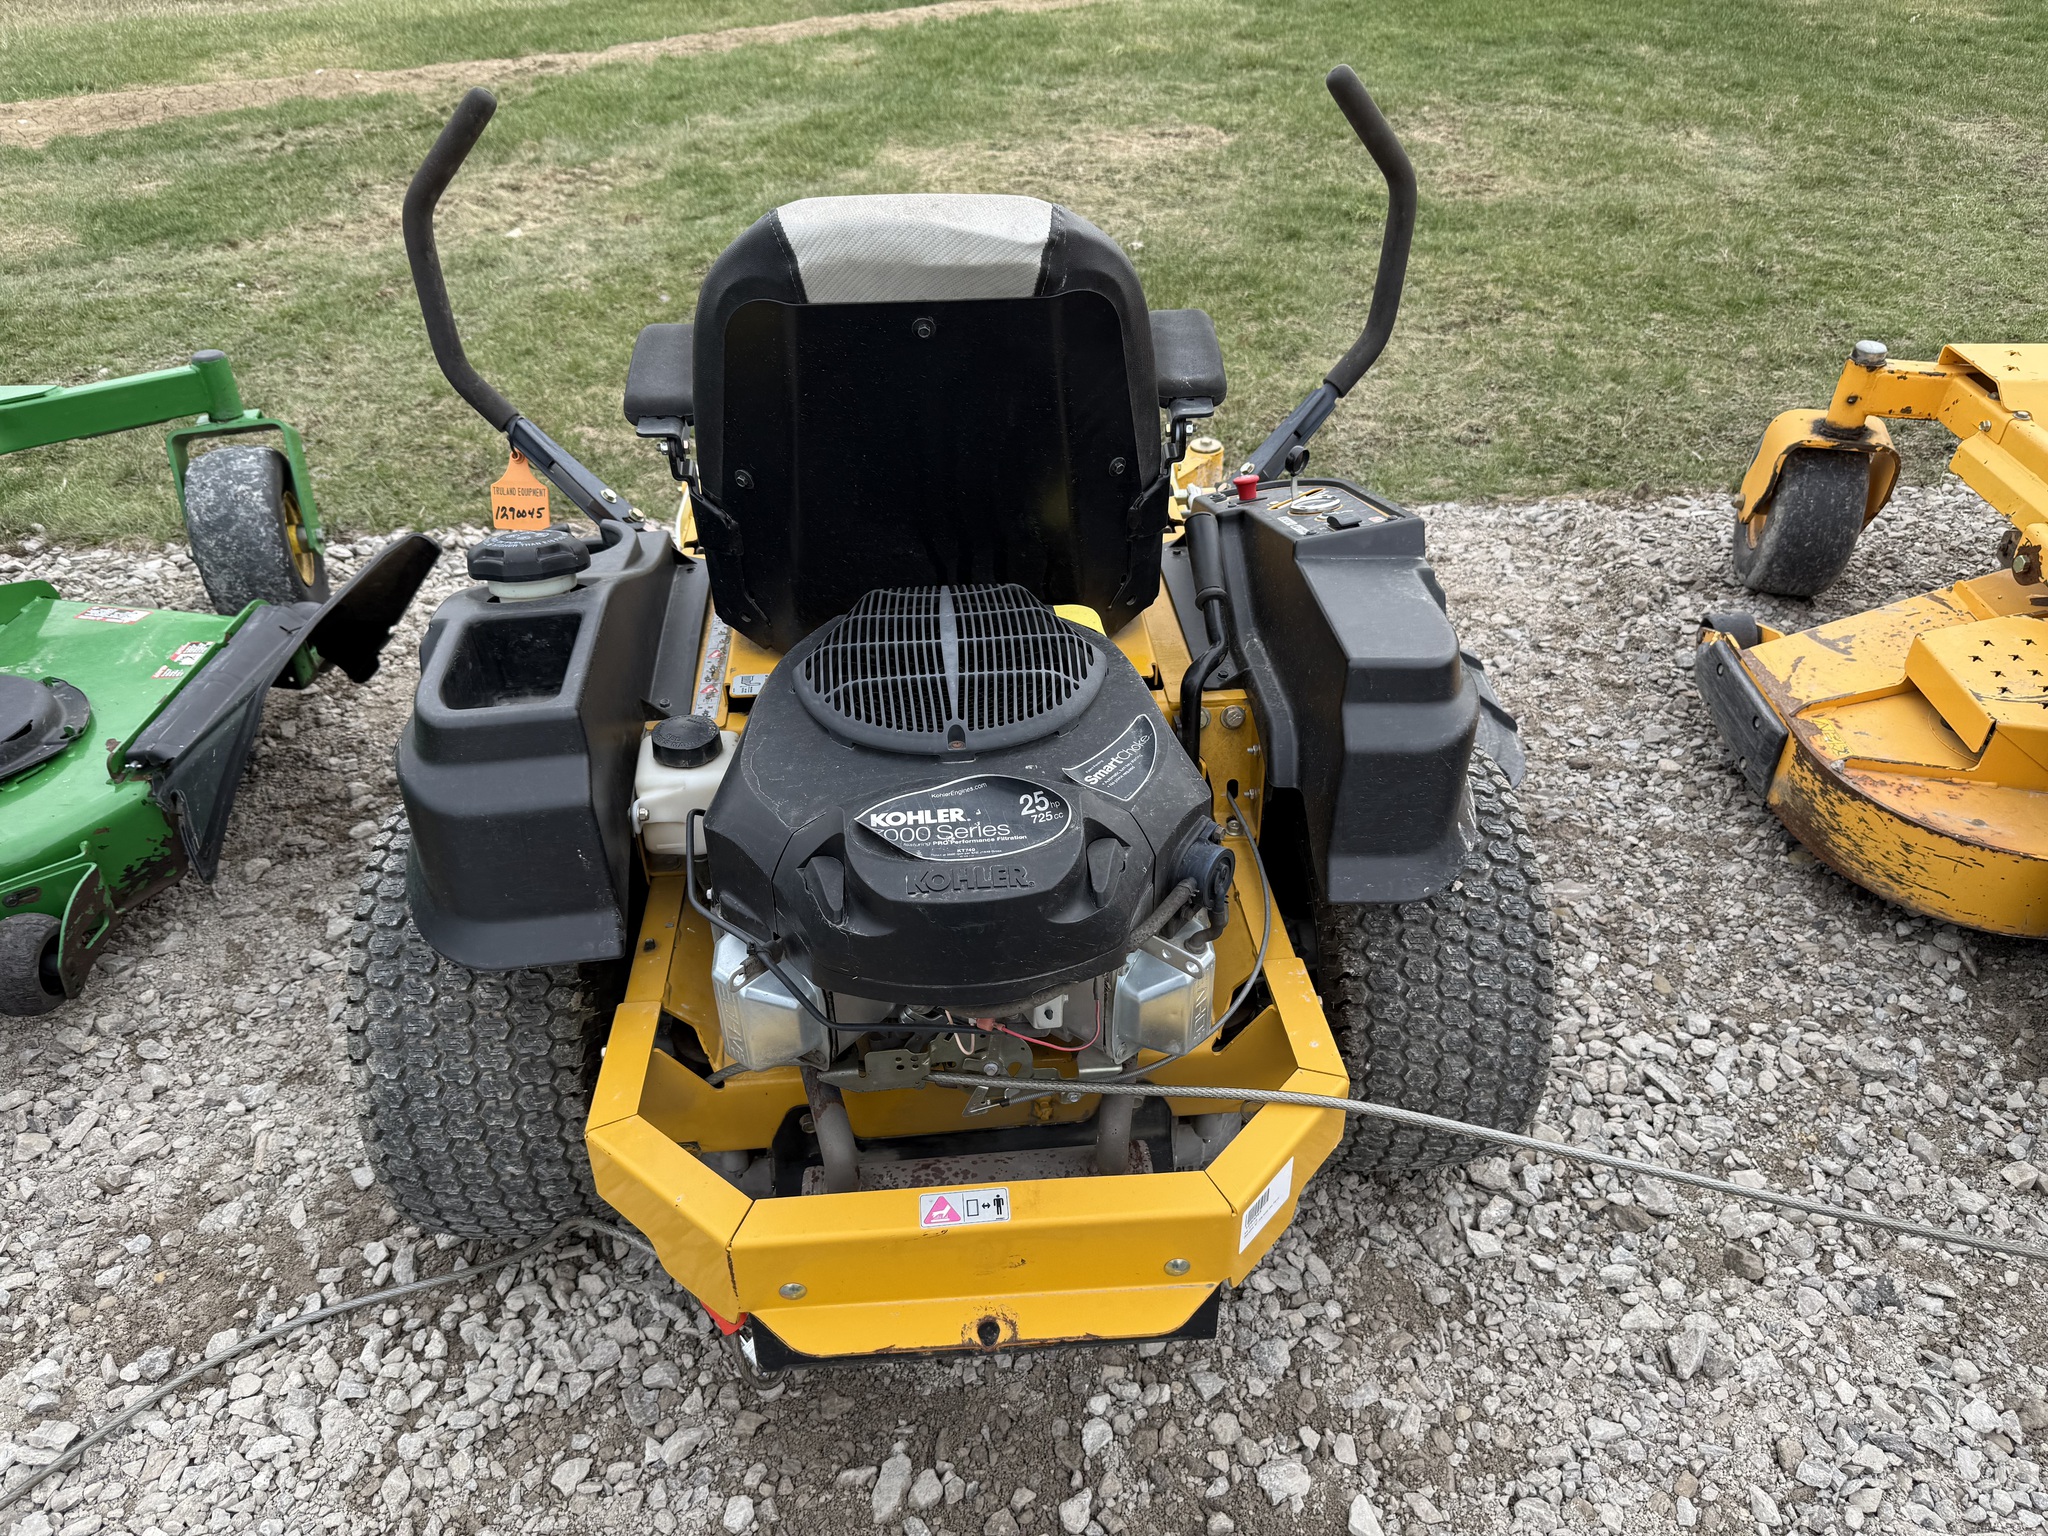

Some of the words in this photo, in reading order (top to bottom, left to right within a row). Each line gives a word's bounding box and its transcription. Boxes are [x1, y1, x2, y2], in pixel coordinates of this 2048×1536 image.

[492, 487, 516, 496] TRULAND
[518, 487, 546, 497] EQUIPMENT
[495, 506, 545, 520] 1290045
[1084, 734, 1150, 785] SmartChoke
[931, 782, 988, 799] KohlerEngines.com
[1019, 790, 1050, 816] 25
[870, 808, 967, 827] KOHLER
[1031, 811, 1053, 824] 725
[1053, 812, 1064, 820] cc
[936, 824, 1011, 841] Series
[949, 837, 996, 845] Performance
[996, 834, 1028, 842] Filtration
